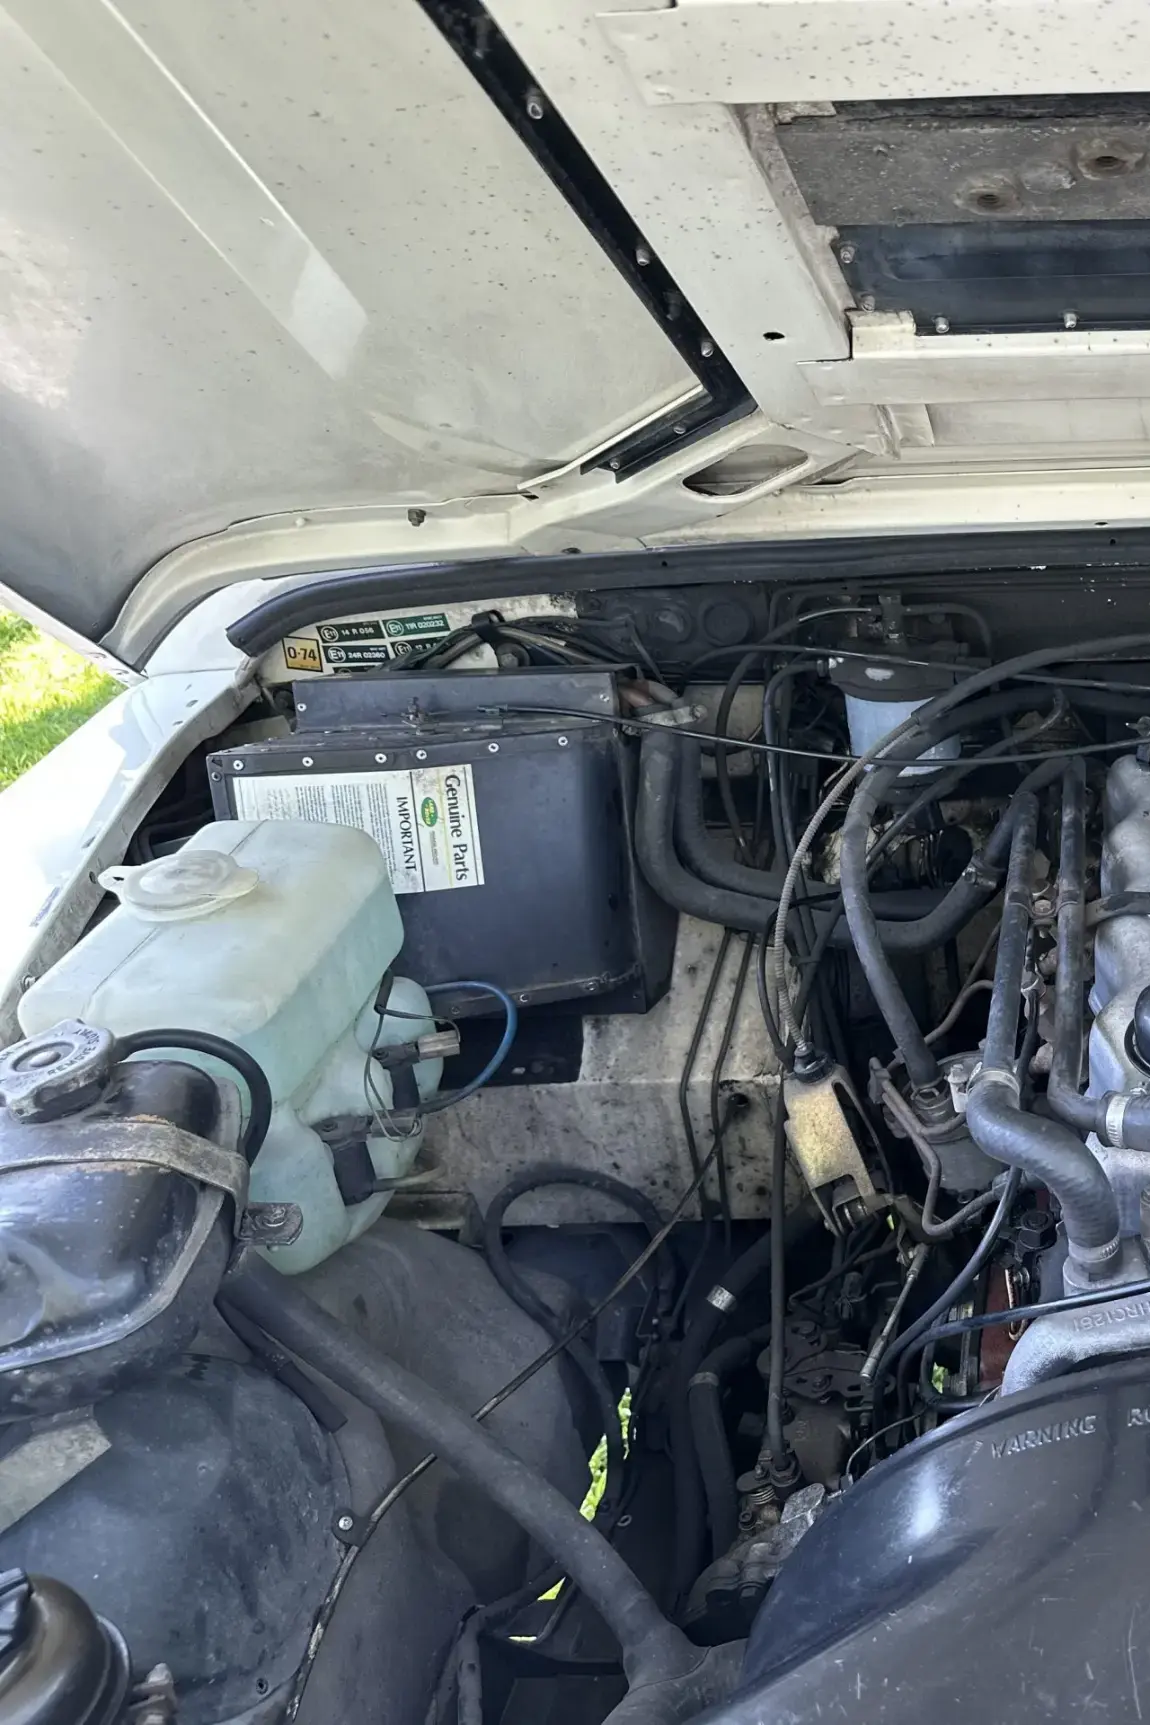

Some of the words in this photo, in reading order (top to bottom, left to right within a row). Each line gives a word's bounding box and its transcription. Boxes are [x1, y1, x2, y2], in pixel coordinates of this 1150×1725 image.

[444, 774, 464, 838] Genuine
[396, 796, 417, 872] IMPORTANT
[452, 843, 469, 881] Parts
[991, 1415, 1097, 1459] WARNING
